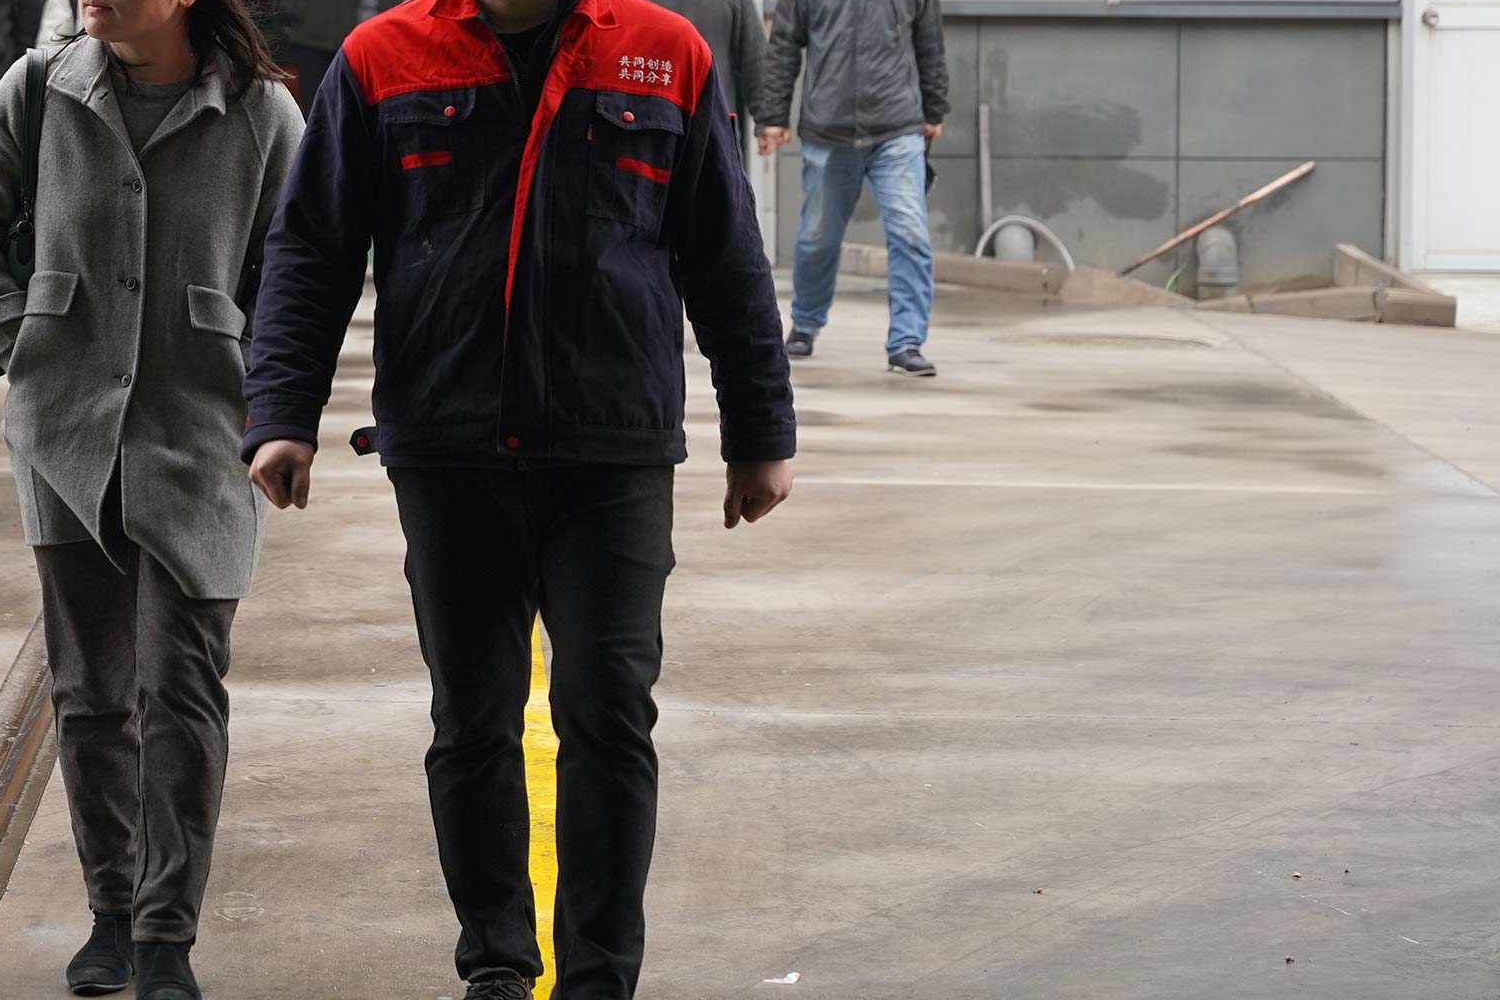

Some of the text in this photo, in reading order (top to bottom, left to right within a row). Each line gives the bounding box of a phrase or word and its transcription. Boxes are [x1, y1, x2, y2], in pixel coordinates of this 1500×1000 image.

[618, 55, 673, 73] 共同创造
[618, 68, 672, 86] 共同分享
